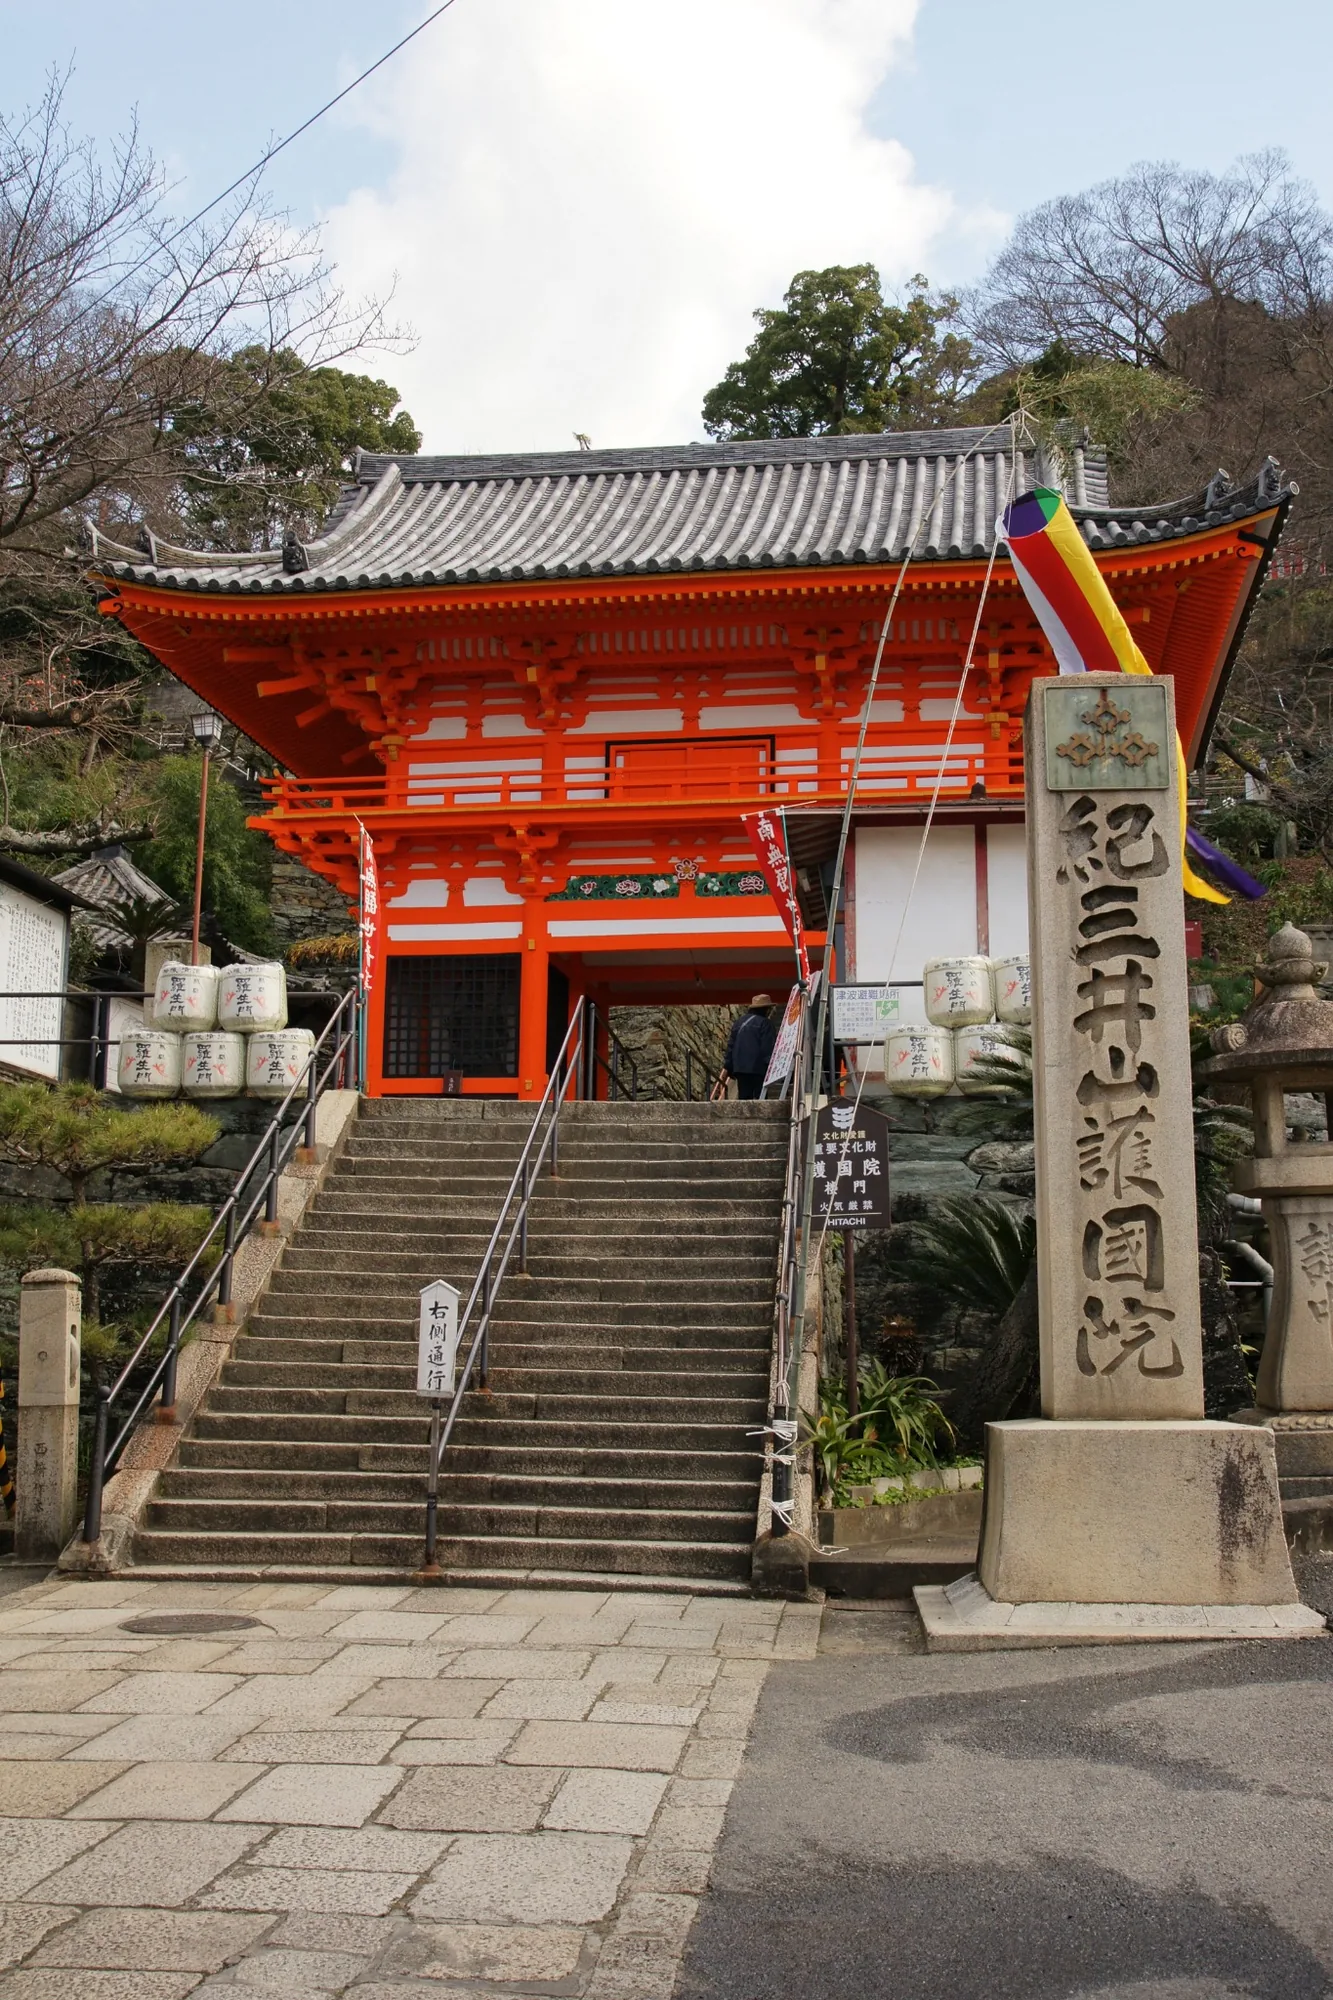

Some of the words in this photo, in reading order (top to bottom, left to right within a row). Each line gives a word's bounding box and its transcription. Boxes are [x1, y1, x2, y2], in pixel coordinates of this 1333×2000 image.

[169, 977, 186, 1015] 羅生門
[236, 978, 253, 1017] 羅生門
[945, 971, 966, 1013] 羅生門
[134, 1043, 152, 1083] 羅生門
[196, 1044, 212, 1083] 羅生門
[267, 1043, 285, 1083] 羅生門
[909, 1036, 929, 1078] 羅生門
[1056, 796, 1185, 1379] 紀三井山護國院
[814, 1141, 877, 1155] 重要文化財
[813, 1158, 881, 1178] 護国院
[824, 1180, 866, 1195] 楼門
[820, 1200, 873, 1212] 火気厳禁
[827, 1217, 866, 1226] HITACHI
[427, 1301, 449, 1390] 右側通行
